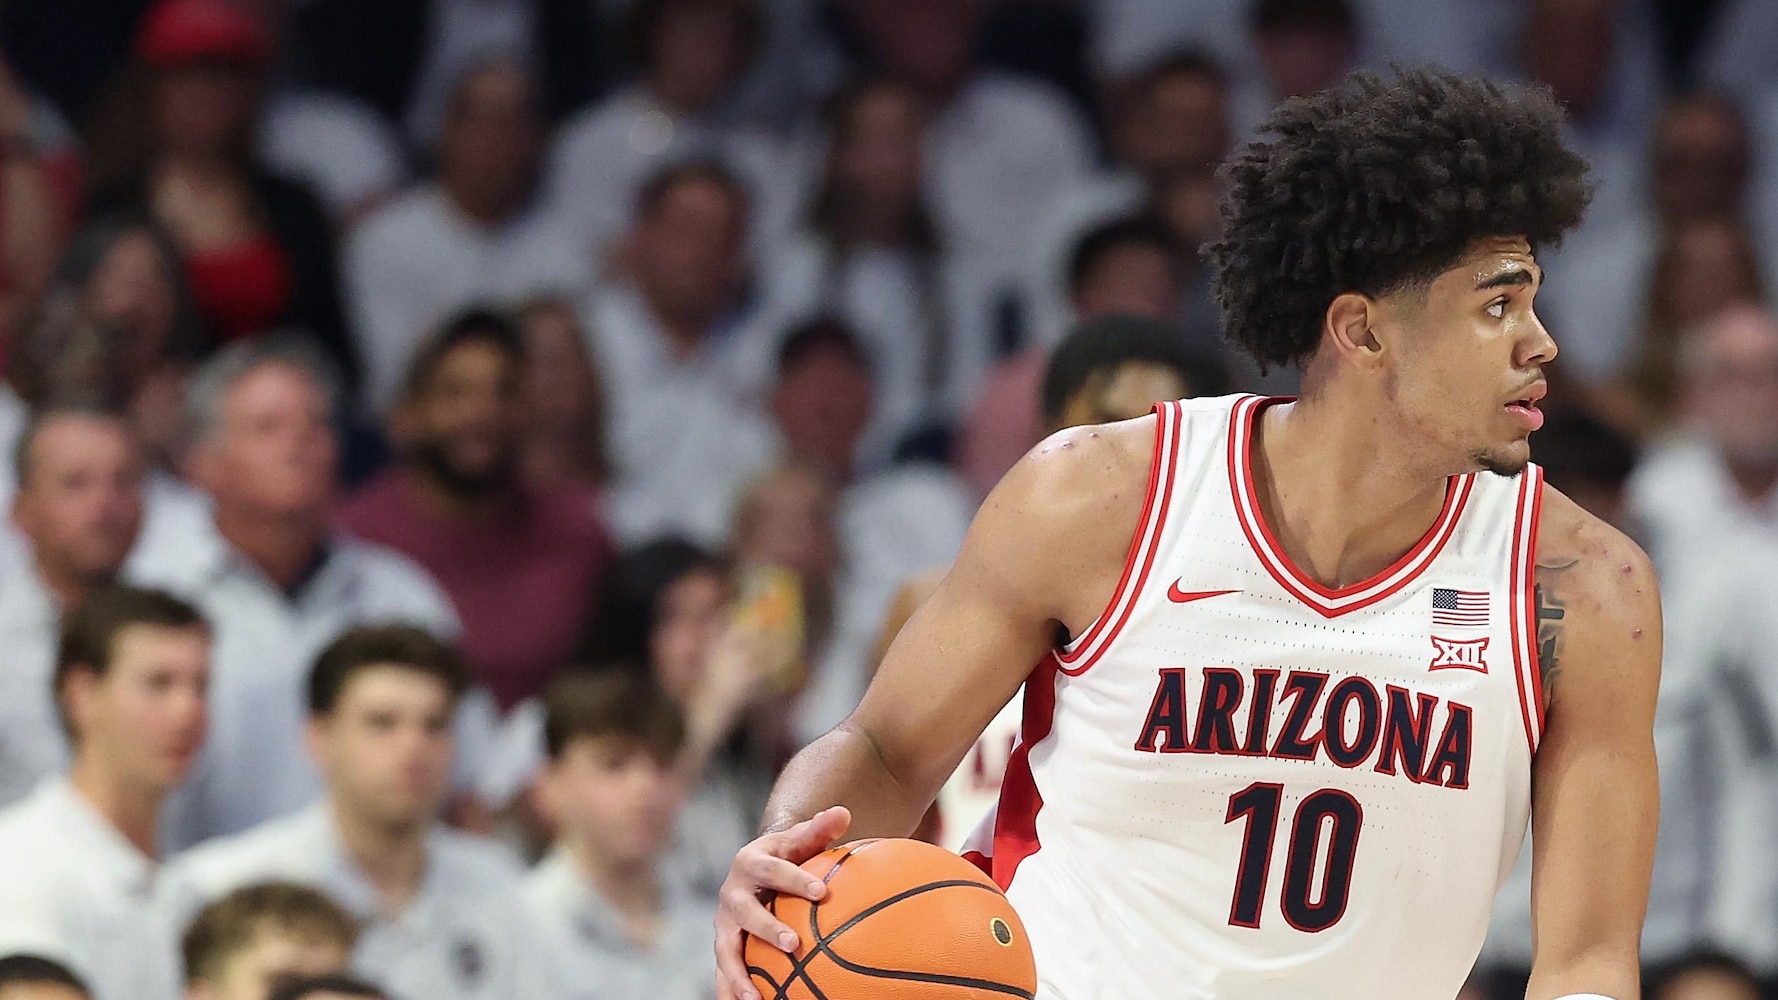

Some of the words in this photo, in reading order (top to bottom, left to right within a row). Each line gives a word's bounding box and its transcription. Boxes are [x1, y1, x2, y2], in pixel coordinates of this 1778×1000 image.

[1428, 635, 1489, 674] XII
[1134, 667, 1473, 790] ARIZONA
[1224, 781, 1363, 933] 10
